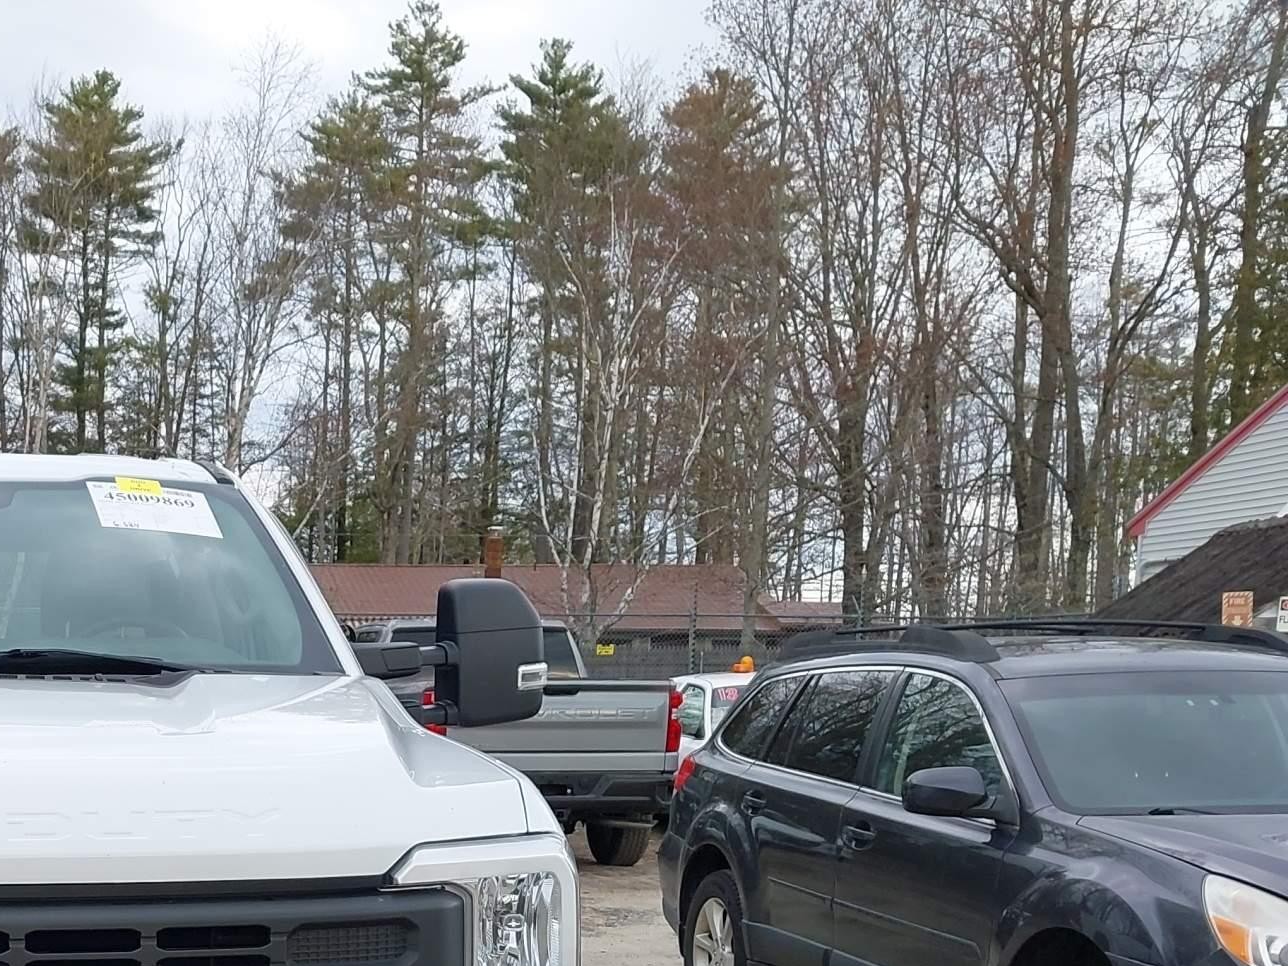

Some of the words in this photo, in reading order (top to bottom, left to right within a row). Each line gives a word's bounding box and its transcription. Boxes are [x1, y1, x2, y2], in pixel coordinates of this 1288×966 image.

[103, 491, 195, 508] 45009869
[539, 706, 657, 720] VROLET
[5, 807, 280, 841] DUTY
